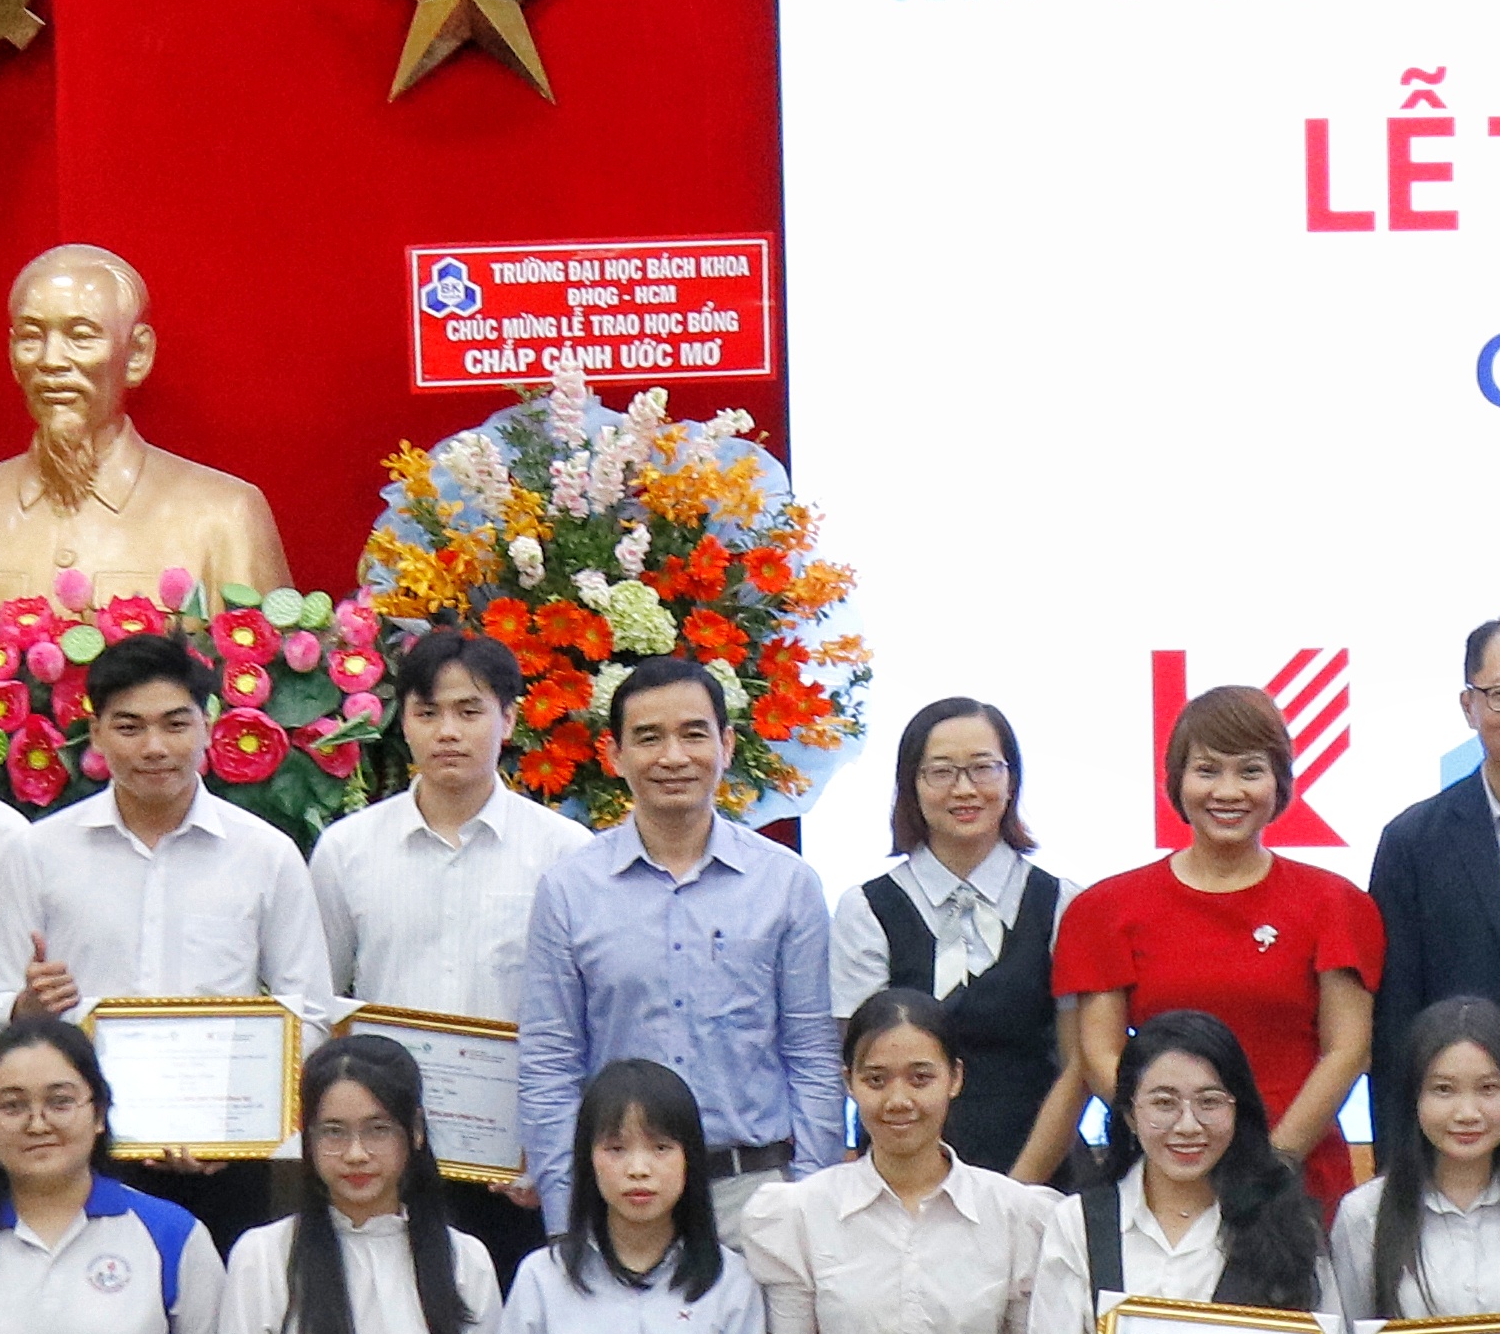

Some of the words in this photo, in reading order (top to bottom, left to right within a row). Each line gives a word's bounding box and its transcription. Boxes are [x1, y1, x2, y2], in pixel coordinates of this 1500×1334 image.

[1303, 65, 1460, 234] LỄ
[491, 257, 566, 284] TRƯỜNG
[568, 260, 601, 285] ĐẠI
[604, 258, 643, 284] HỌC
[646, 252, 697, 279] BÁCH
[699, 255, 750, 278] KHOA
[567, 286, 619, 308] ĐHQG
[634, 284, 677, 304] HCM
[446, 314, 499, 341] CHÚC
[502, 312, 558, 339] MỪNG
[561, 306, 585, 337] LỄ
[589, 314, 641, 336] TRAO
[644, 313, 684, 338] HỌC
[687, 301, 740, 334] BỔNG
[464, 339, 537, 374] CHẮP
[541, 340, 613, 369] CÁNH
[620, 338, 674, 368] ƯỚC
[679, 338, 723, 366] MƠ
